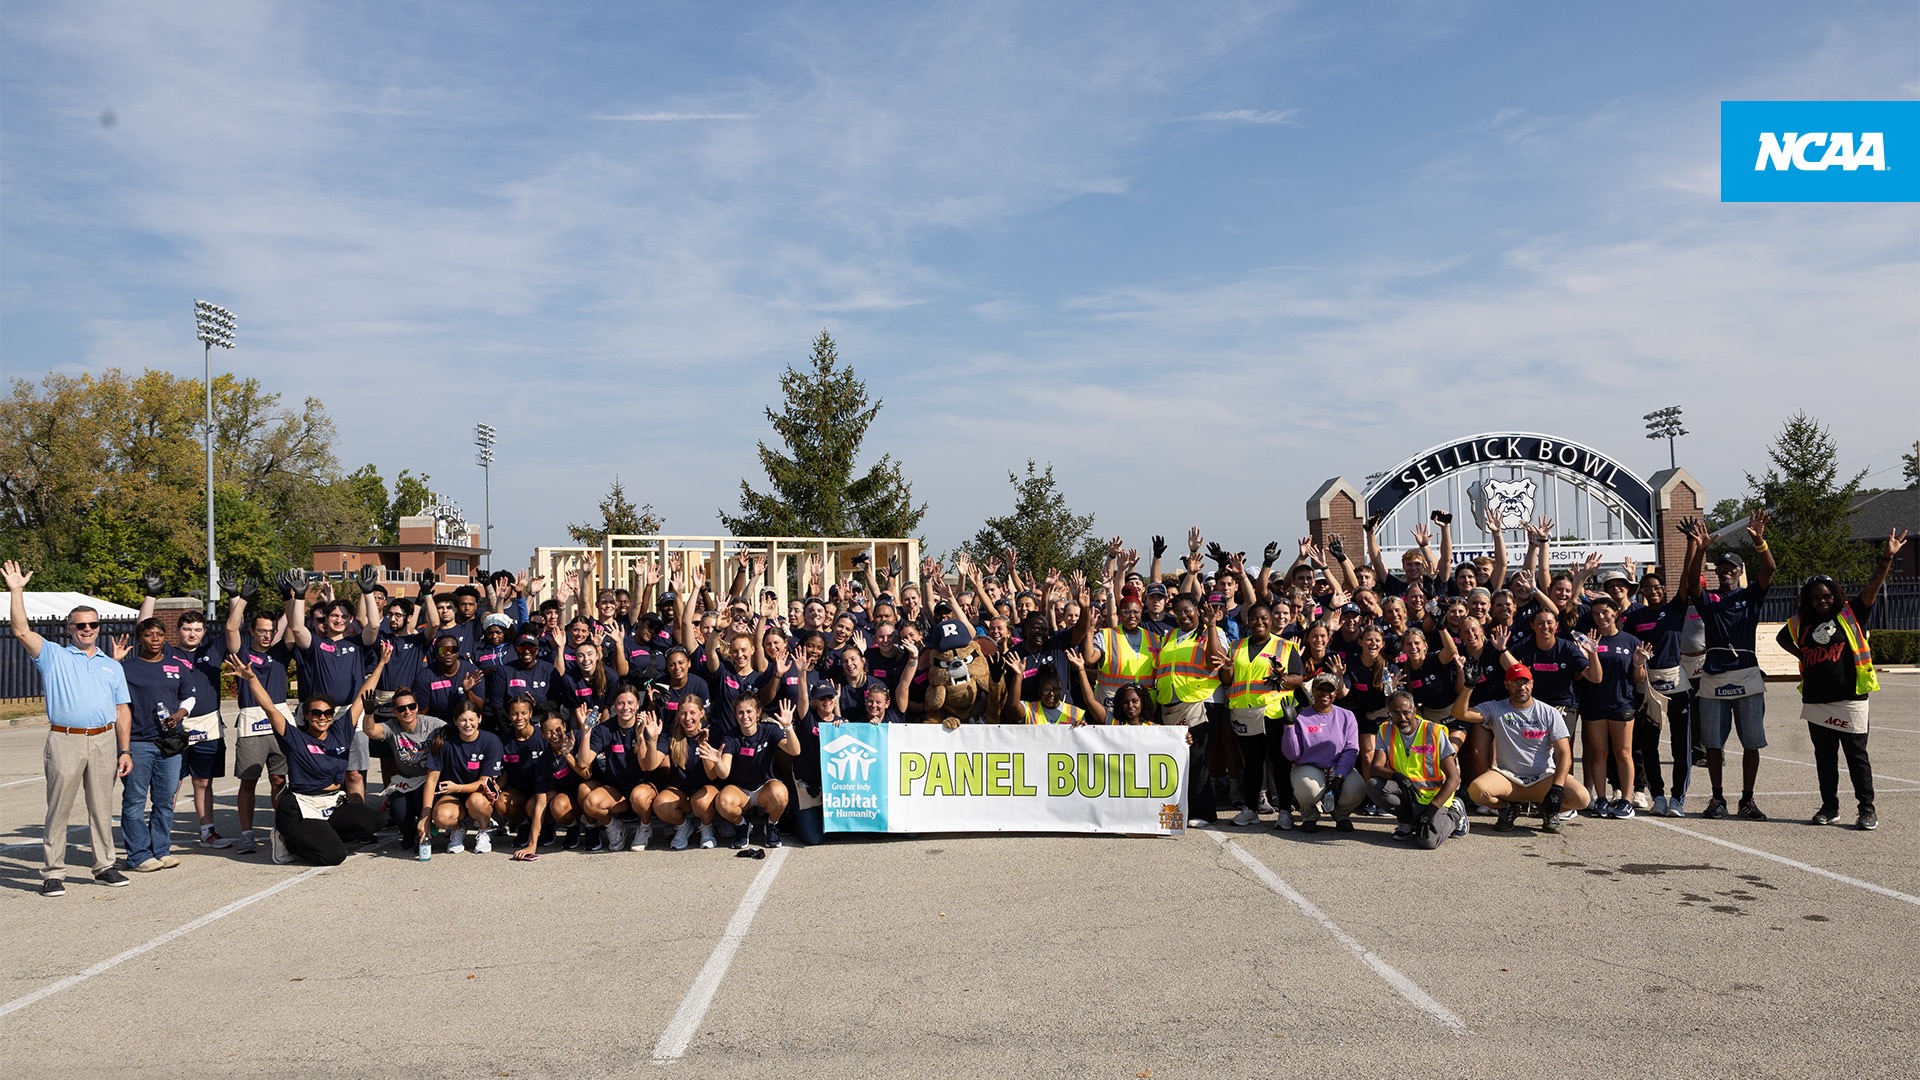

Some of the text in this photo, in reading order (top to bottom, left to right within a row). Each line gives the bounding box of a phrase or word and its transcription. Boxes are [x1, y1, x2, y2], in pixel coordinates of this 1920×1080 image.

[1401, 437, 1618, 492] SELLICK BOWL
[942, 623, 959, 638] R
[1800, 642, 1846, 668] FRIDAY
[1692, 667, 1703, 676] AC
[1824, 716, 1849, 729] ACE
[899, 751, 1180, 799] PANEL BUILD
[831, 782, 871, 792] Greater Indy
[822, 792, 878, 808] Habitat
[836, 809, 878, 820] Humanity
[1158, 813, 1184, 822] TIGER
[1159, 821, 1184, 830] TEAM
